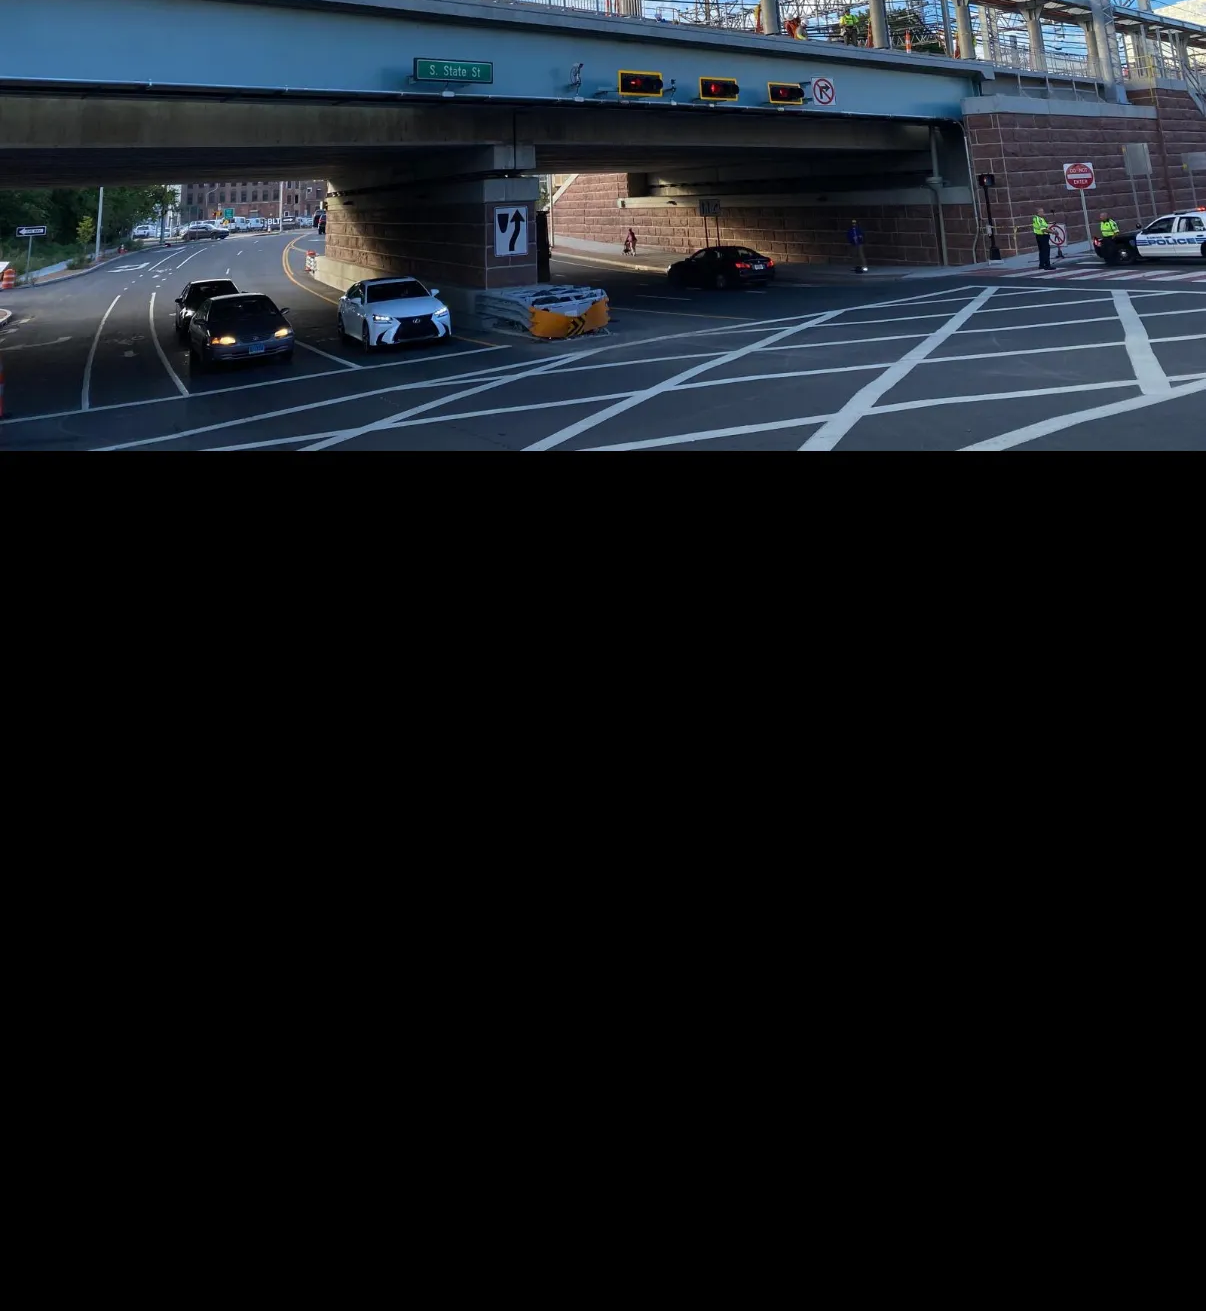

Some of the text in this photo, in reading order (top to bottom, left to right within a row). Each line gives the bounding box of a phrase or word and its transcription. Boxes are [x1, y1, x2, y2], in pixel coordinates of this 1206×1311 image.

[429, 64, 481, 78] S. State St
[1148, 237, 1197, 246] POLICE
